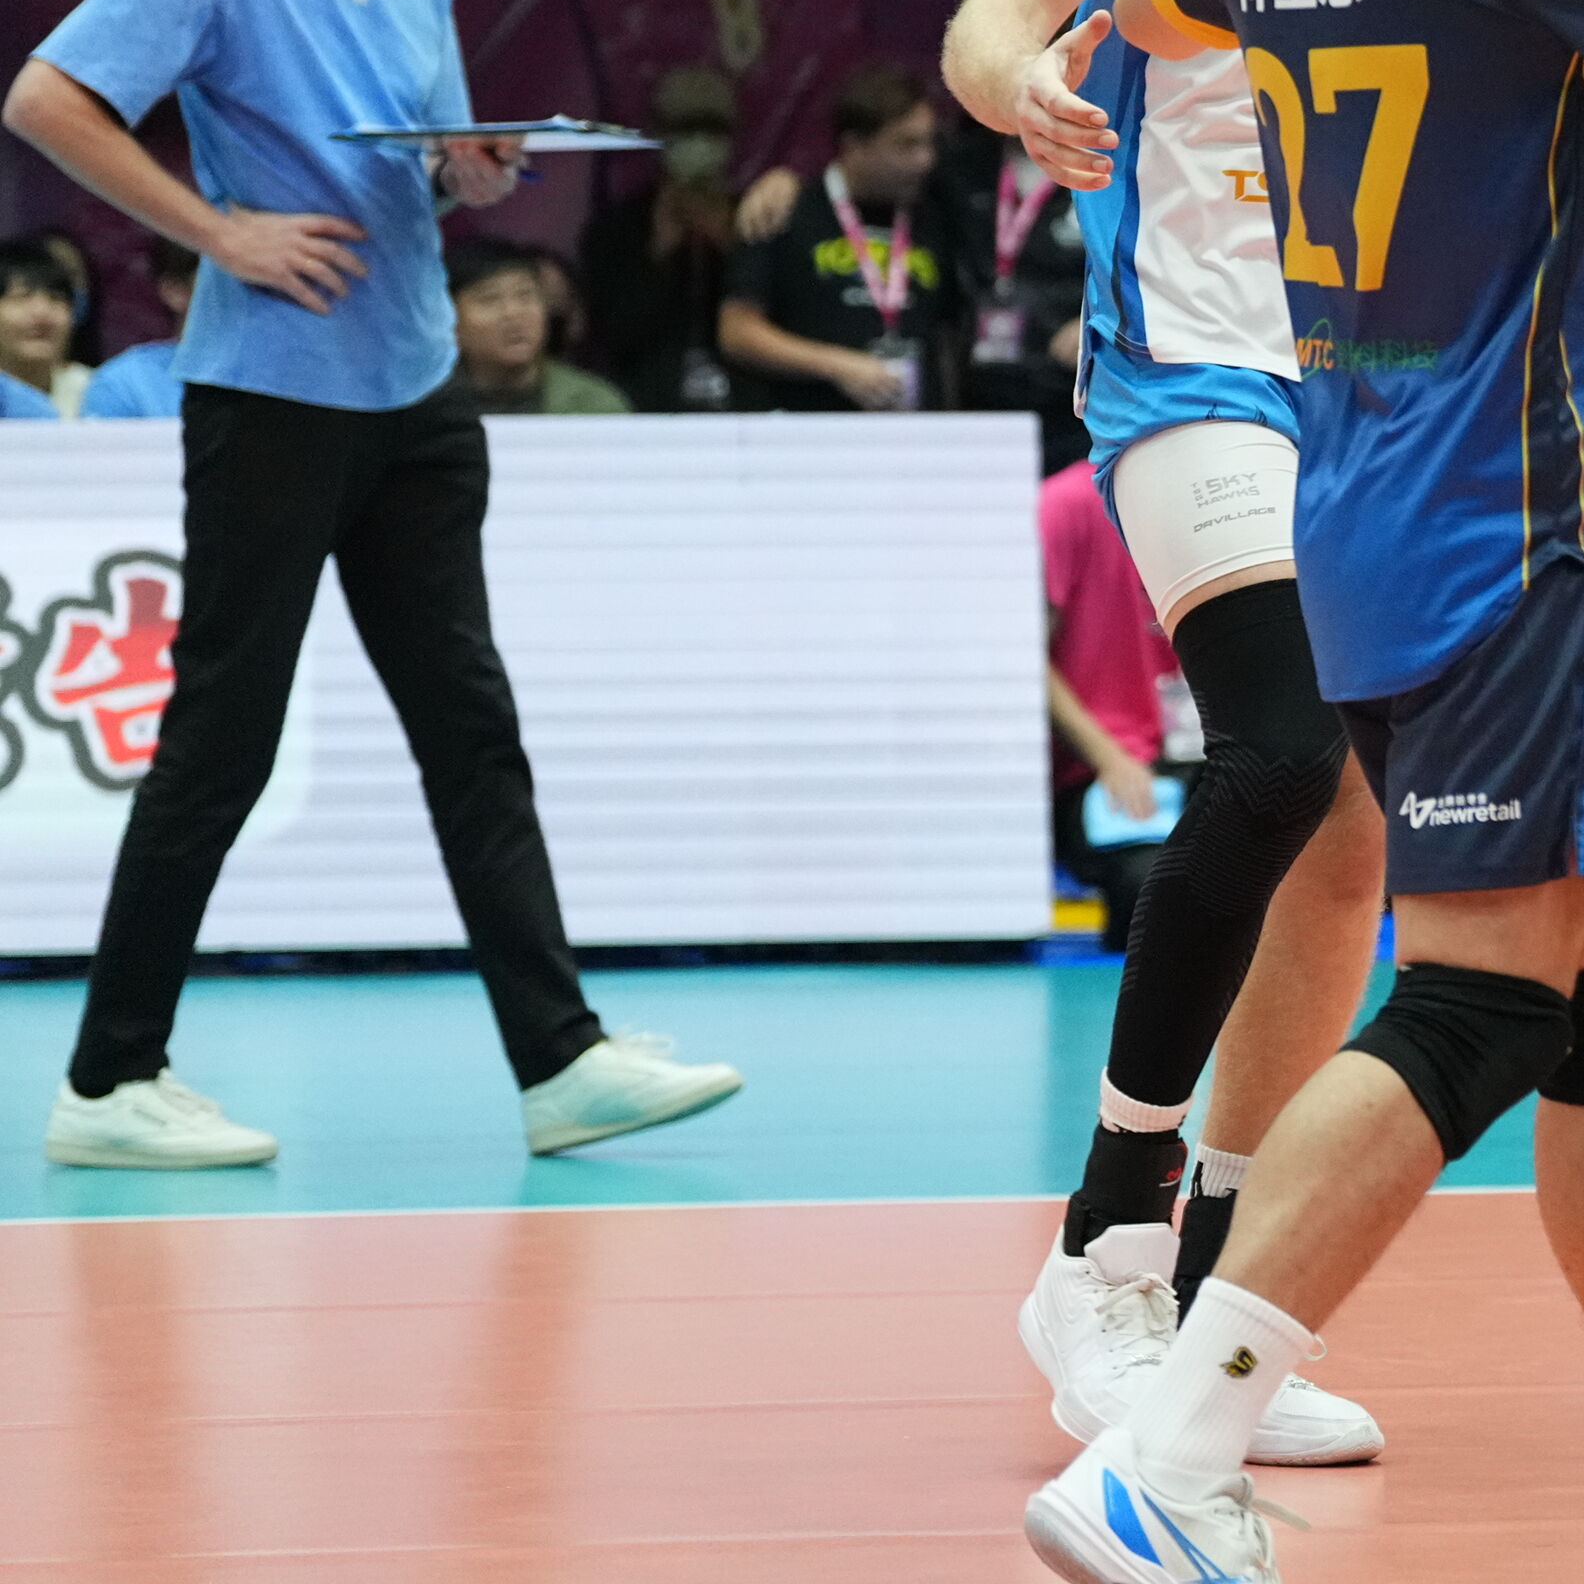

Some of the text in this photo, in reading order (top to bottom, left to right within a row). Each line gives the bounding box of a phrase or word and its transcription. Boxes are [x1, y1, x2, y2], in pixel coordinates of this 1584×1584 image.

[1245, 43, 1430, 292] 27
[1296, 338, 1336, 371] MTC
[1428, 798, 1522, 827] newretail
